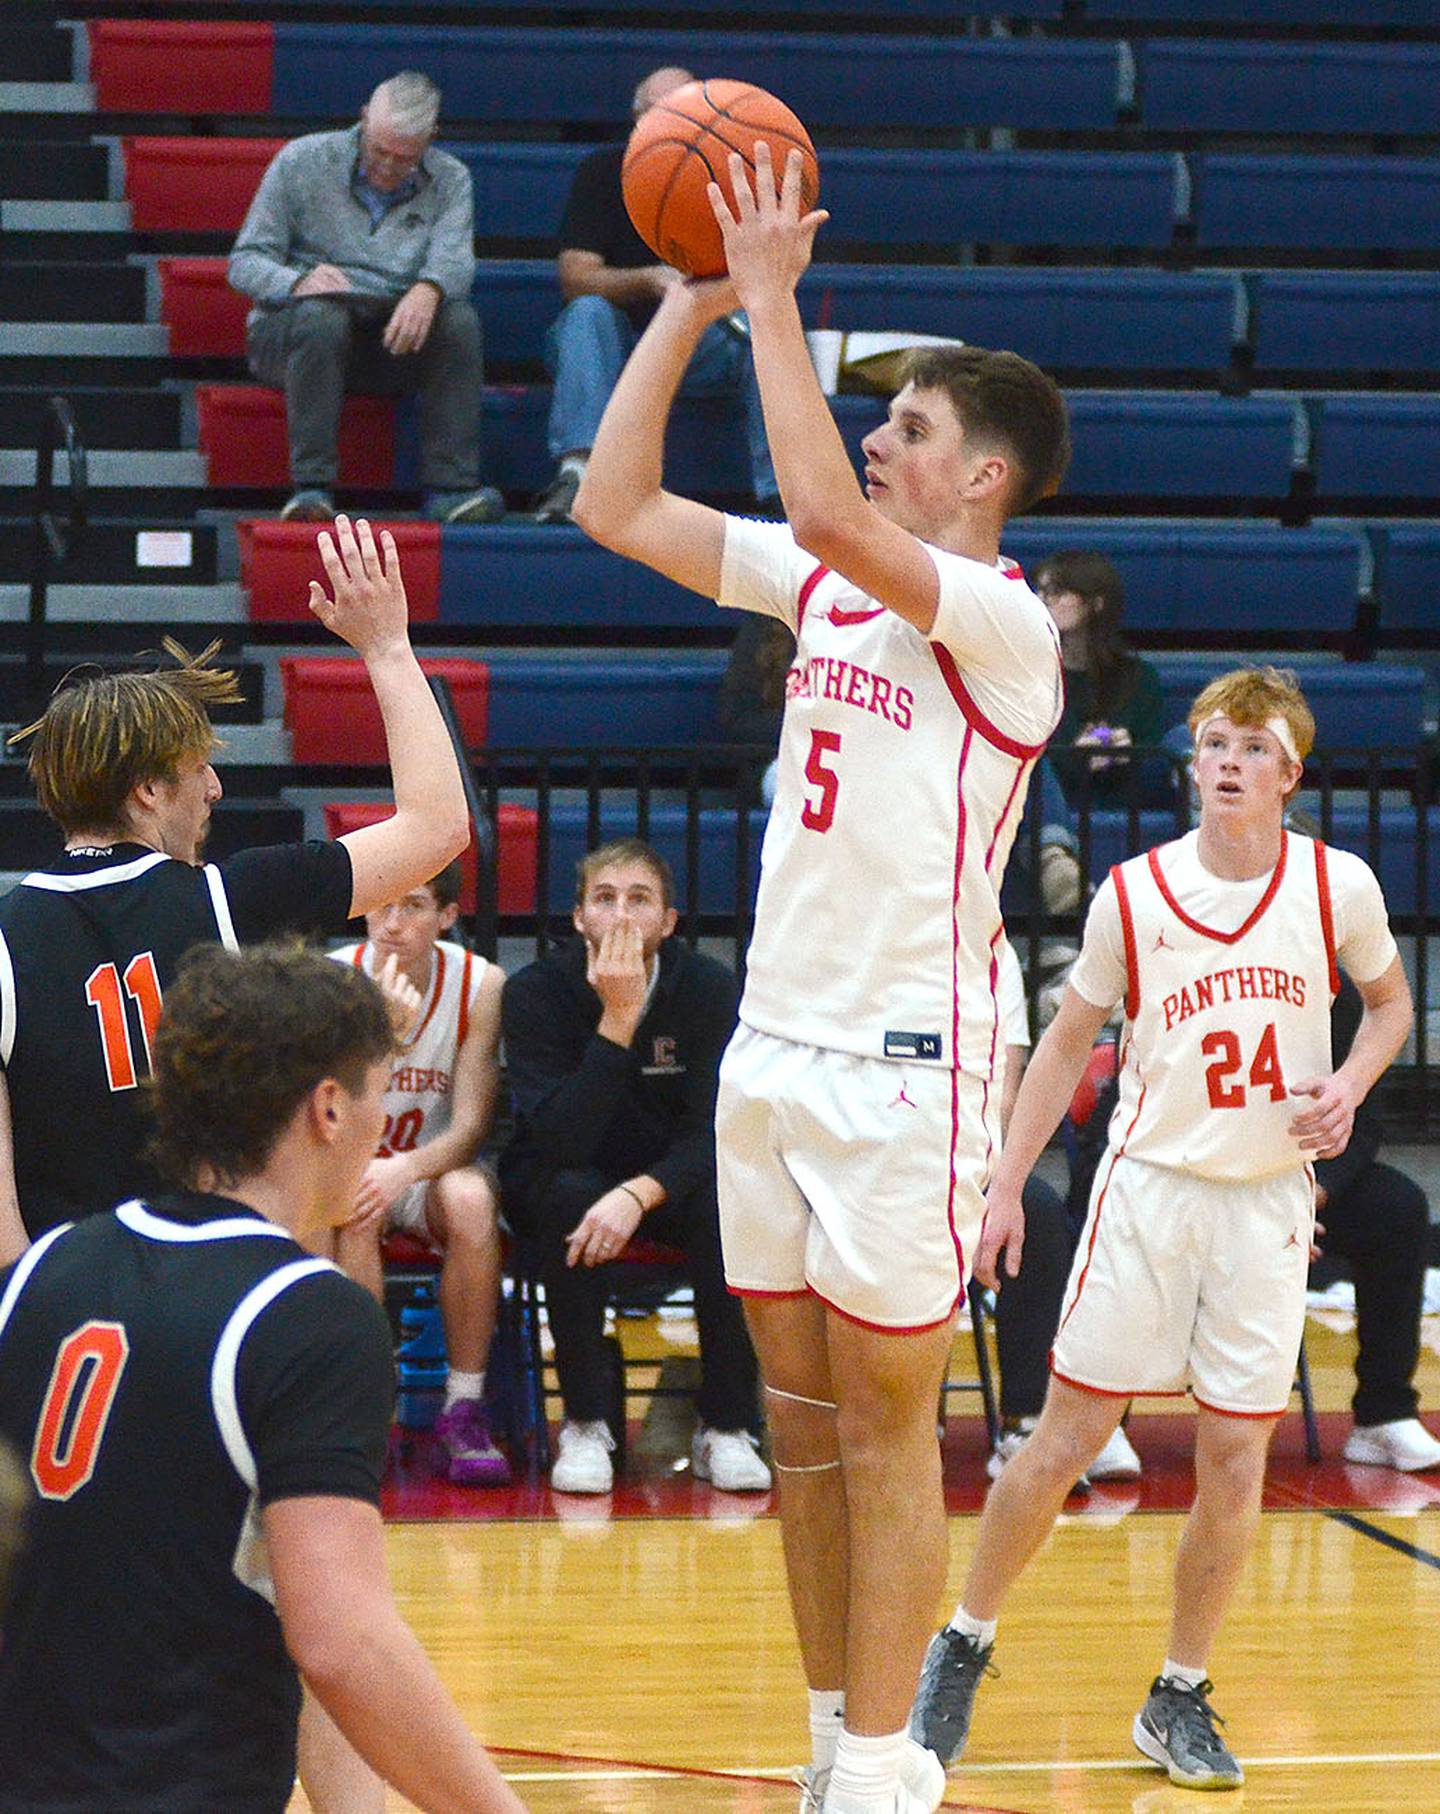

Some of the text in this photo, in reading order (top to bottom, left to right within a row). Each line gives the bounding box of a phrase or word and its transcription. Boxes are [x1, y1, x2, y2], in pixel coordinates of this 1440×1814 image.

[801, 728, 842, 834] 5
[85, 950, 164, 1092] 11
[1162, 966, 1307, 1032] PANTHERS
[1201, 1022, 1288, 1110] 24
[30, 1320, 130, 1501] 0
